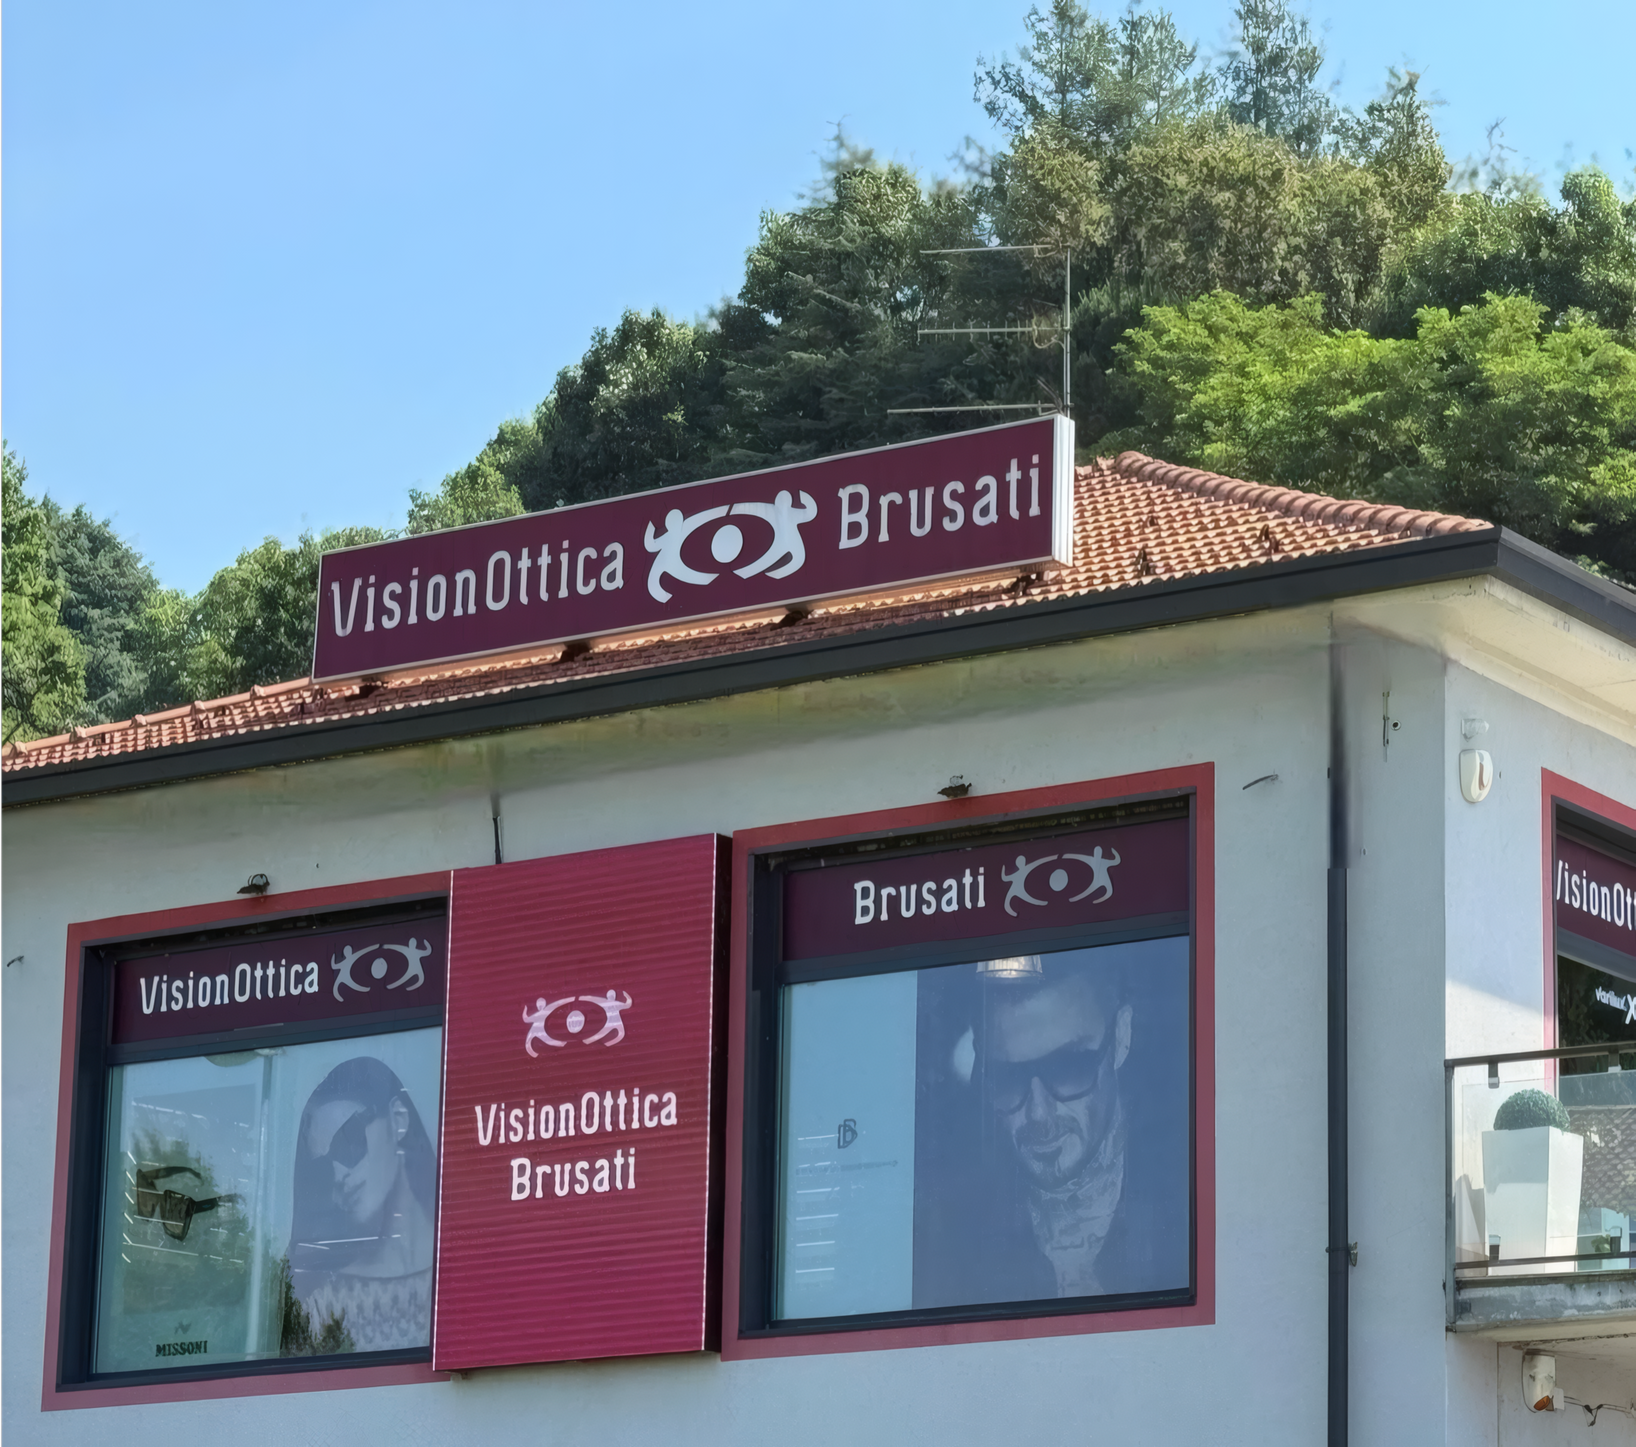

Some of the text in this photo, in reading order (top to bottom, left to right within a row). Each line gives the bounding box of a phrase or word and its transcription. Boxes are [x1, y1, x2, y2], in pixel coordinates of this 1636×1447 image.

[331, 454, 1041, 637] VisionOttica Brusati
[854, 867, 985, 925] Brusati
[140, 958, 319, 1015] VisionOttica
[475, 1087, 678, 1146] VisionOttica
[510, 1147, 636, 1201] Brusati
[155, 1340, 208, 1357] MISSONI
